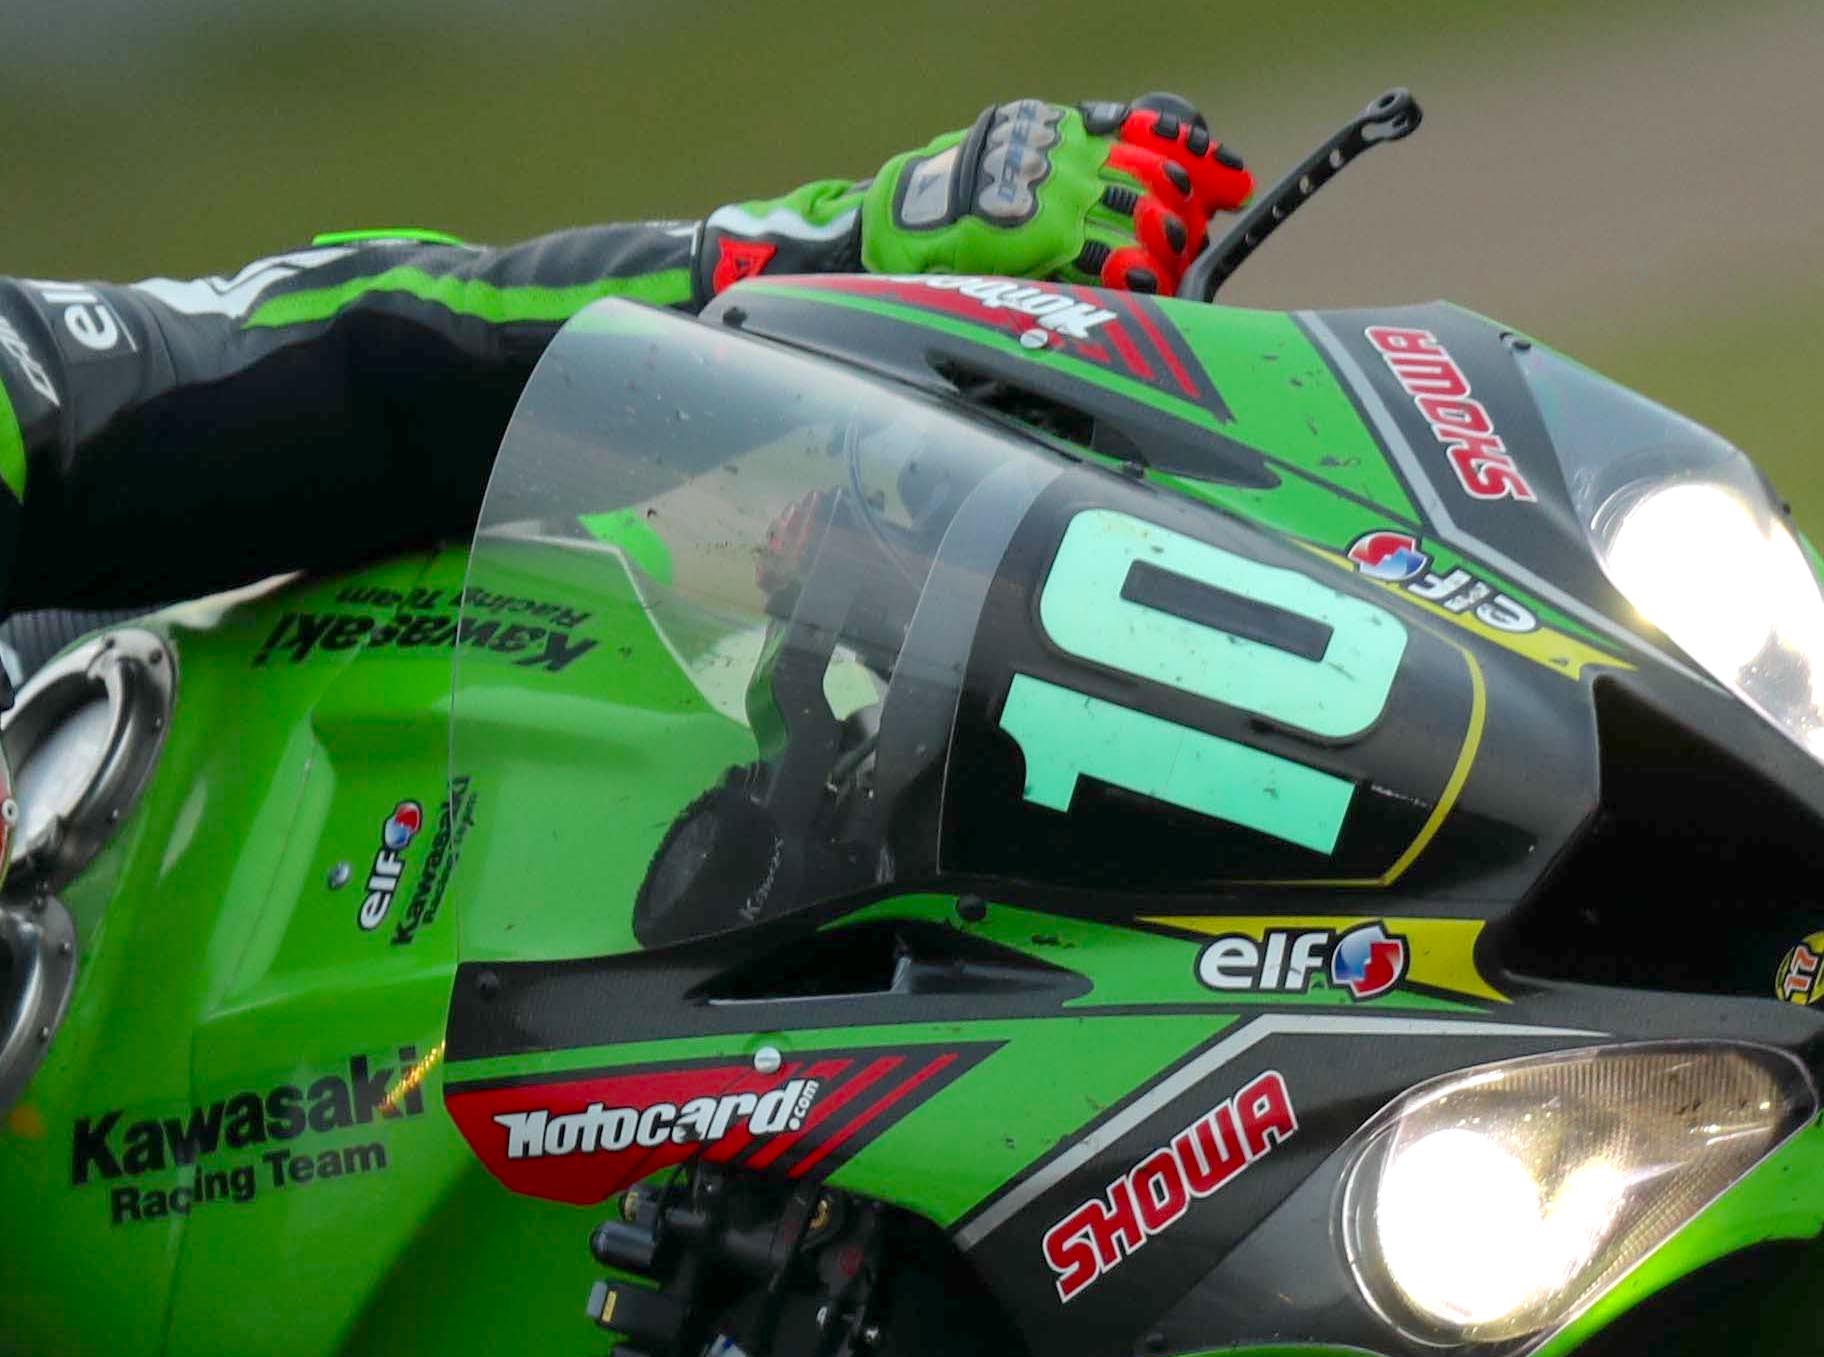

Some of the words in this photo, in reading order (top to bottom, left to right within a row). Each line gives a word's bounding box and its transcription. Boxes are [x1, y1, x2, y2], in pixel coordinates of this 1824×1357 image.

[1365, 325, 1537, 503] SHOWA
[251, 611, 599, 673] Kawasaki
[1412, 567, 1538, 634] elf
[999, 507, 1408, 857] 10
[359, 850, 403, 930] elf
[390, 776, 470, 945] Kawasaki
[1199, 930, 1332, 990] elf
[71, 1046, 424, 1185] Kawasaki
[111, 1162, 256, 1225] Racing
[262, 1136, 387, 1188] Team
[1042, 1070, 1300, 1304] SHOWA
